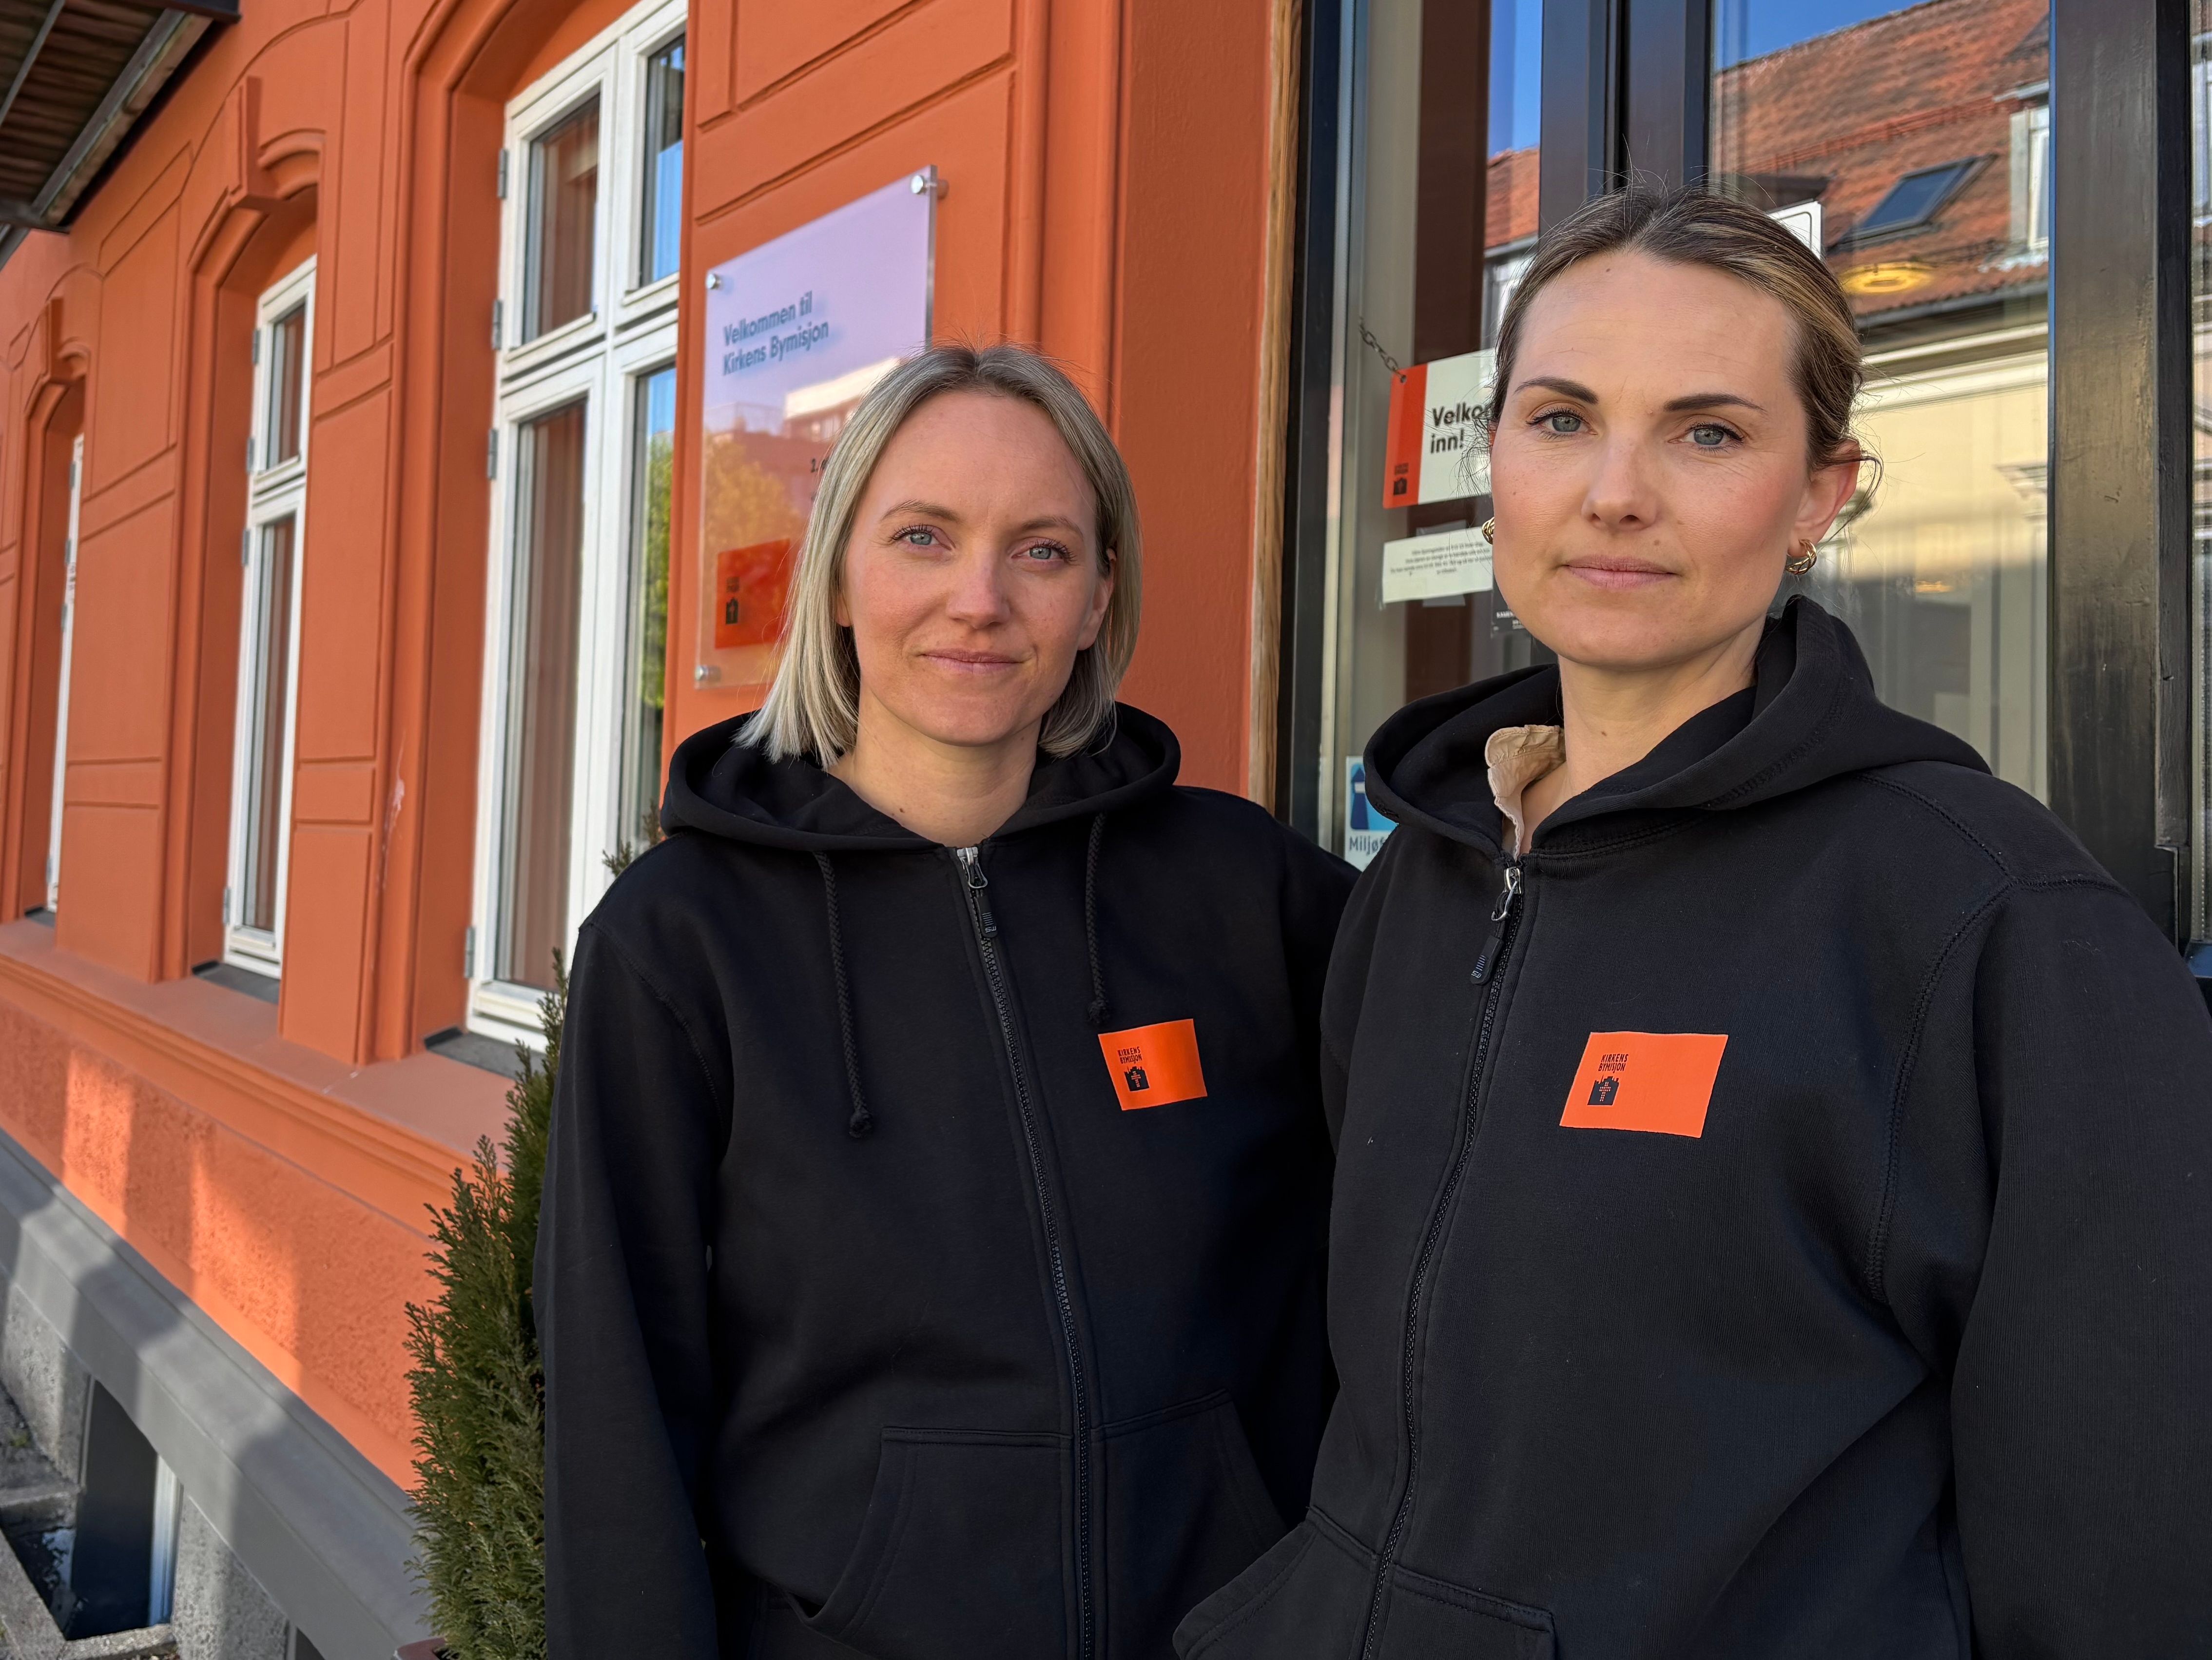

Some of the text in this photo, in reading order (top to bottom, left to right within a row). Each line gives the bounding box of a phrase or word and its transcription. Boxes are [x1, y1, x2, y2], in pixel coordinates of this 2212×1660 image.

[723, 290, 812, 346] Velkommen til
[723, 321, 829, 376] Kirkens Bymisjon
[1430, 428, 1464, 454] inn!
[1117, 1046, 1141, 1057] KIRKENS
[1120, 1054, 1143, 1064] BYMISJON
[1601, 1054, 1629, 1063] KIRKENS
[1598, 1062, 1626, 1074] BYMISJON
